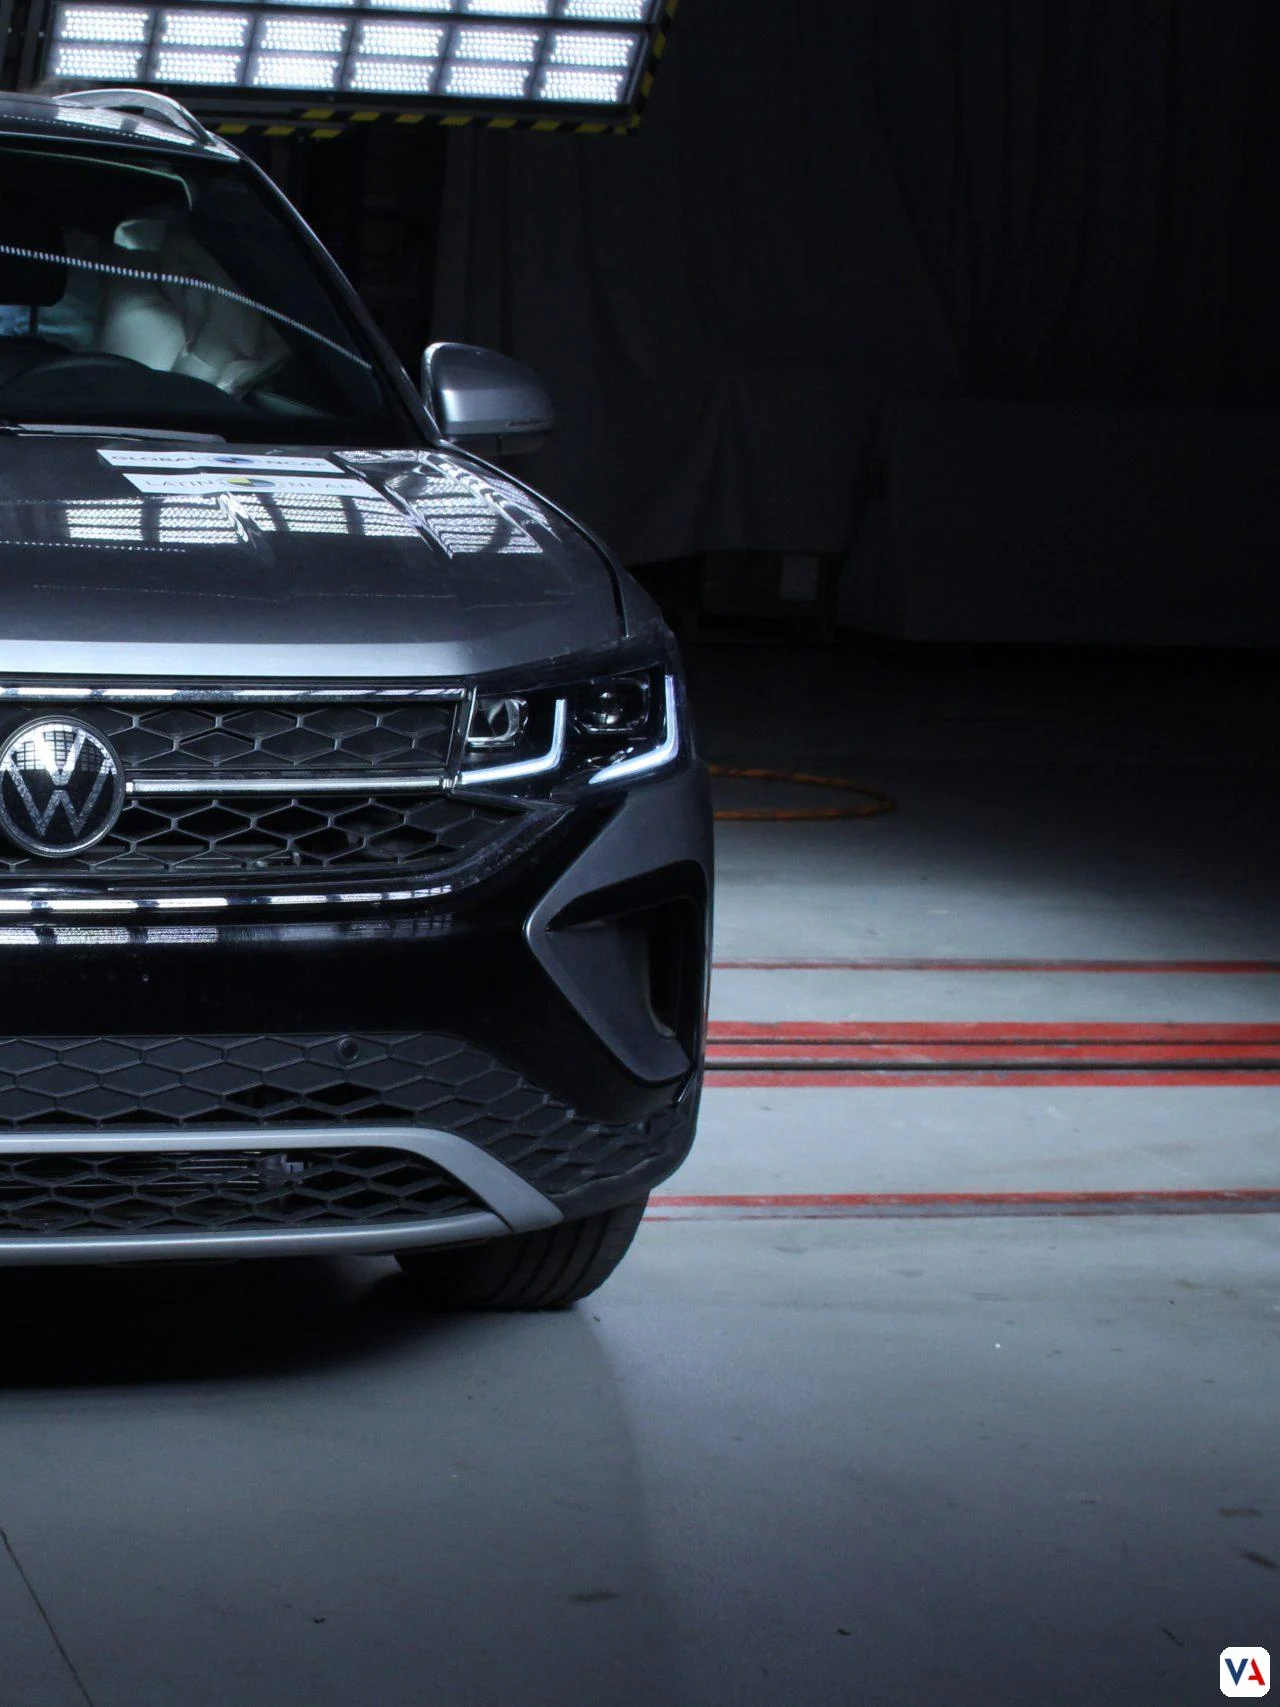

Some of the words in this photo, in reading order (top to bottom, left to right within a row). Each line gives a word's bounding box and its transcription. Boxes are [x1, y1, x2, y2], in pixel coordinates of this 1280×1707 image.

[111, 455, 200, 463] GLOBAL
[144, 480, 214, 488] LATIN
[0, 722, 118, 838] VW
